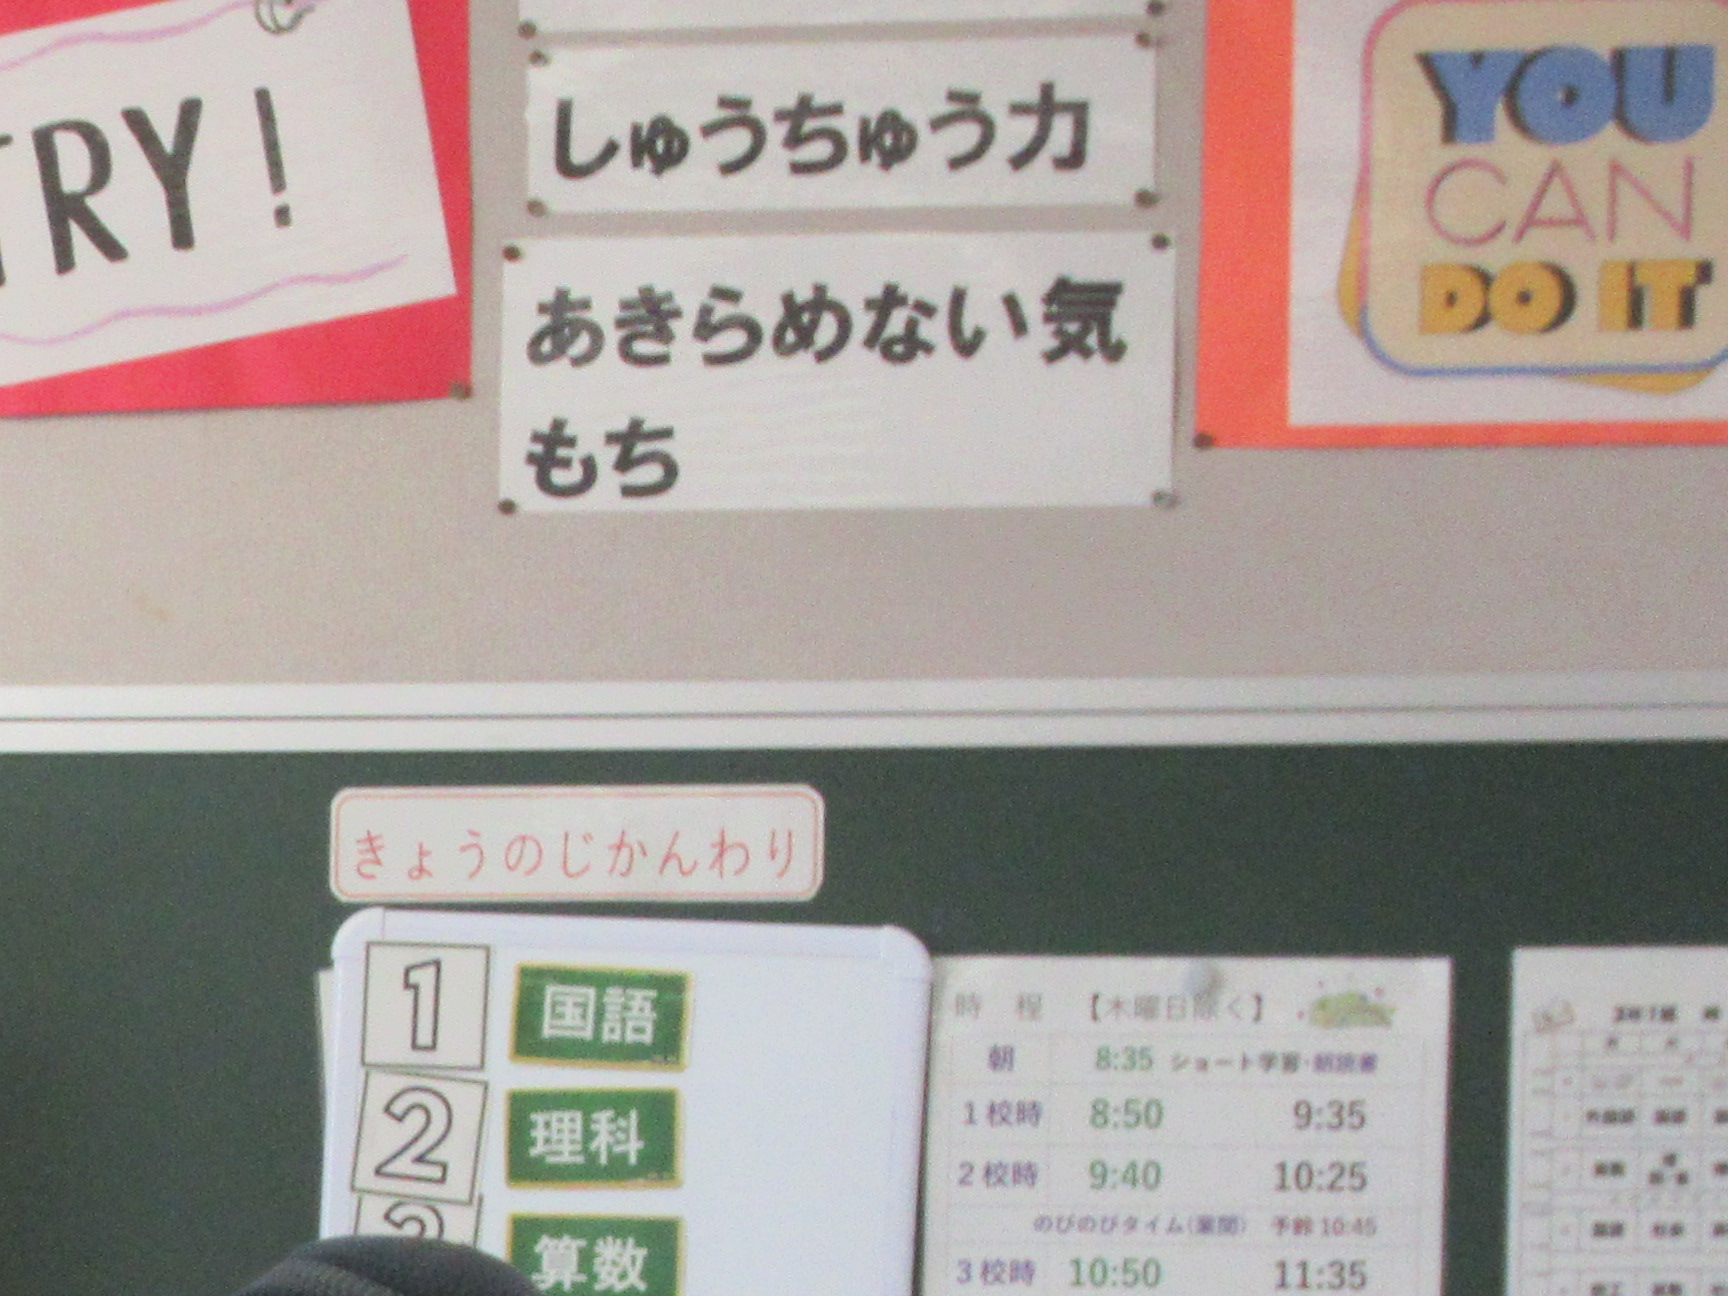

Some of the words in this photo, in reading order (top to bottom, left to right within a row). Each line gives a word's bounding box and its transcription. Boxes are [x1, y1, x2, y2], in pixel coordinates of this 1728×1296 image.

[1417, 43, 1718, 146] YOU
[552, 80, 1091, 183] しゅうちゅう力
[1424, 154, 1703, 246] CAN
[526, 276, 1128, 366] あきらめない気
[1419, 261, 1578, 334] DO
[1596, 257, 1713, 333] IT
[526, 413, 680, 499] もち
[355, 828, 795, 881] きょうのじかんわり
[403, 959, 442, 1052] 1
[543, 984, 659, 1044] 国語
[1096, 1047, 1155, 1072] 8:35
[374, 1087, 453, 1184] 2
[530, 1108, 644, 1168] 理科
[1090, 1100, 1164, 1129] 8:50
[1294, 1101, 1366, 1131] 9:35
[1089, 1161, 1162, 1190] 9:40
[1274, 1162, 1367, 1192] 10:25
[533, 1234, 648, 1293] 算数
[1069, 1258, 1162, 1288] 10:50
[1274, 1260, 1367, 1290] 11:35
